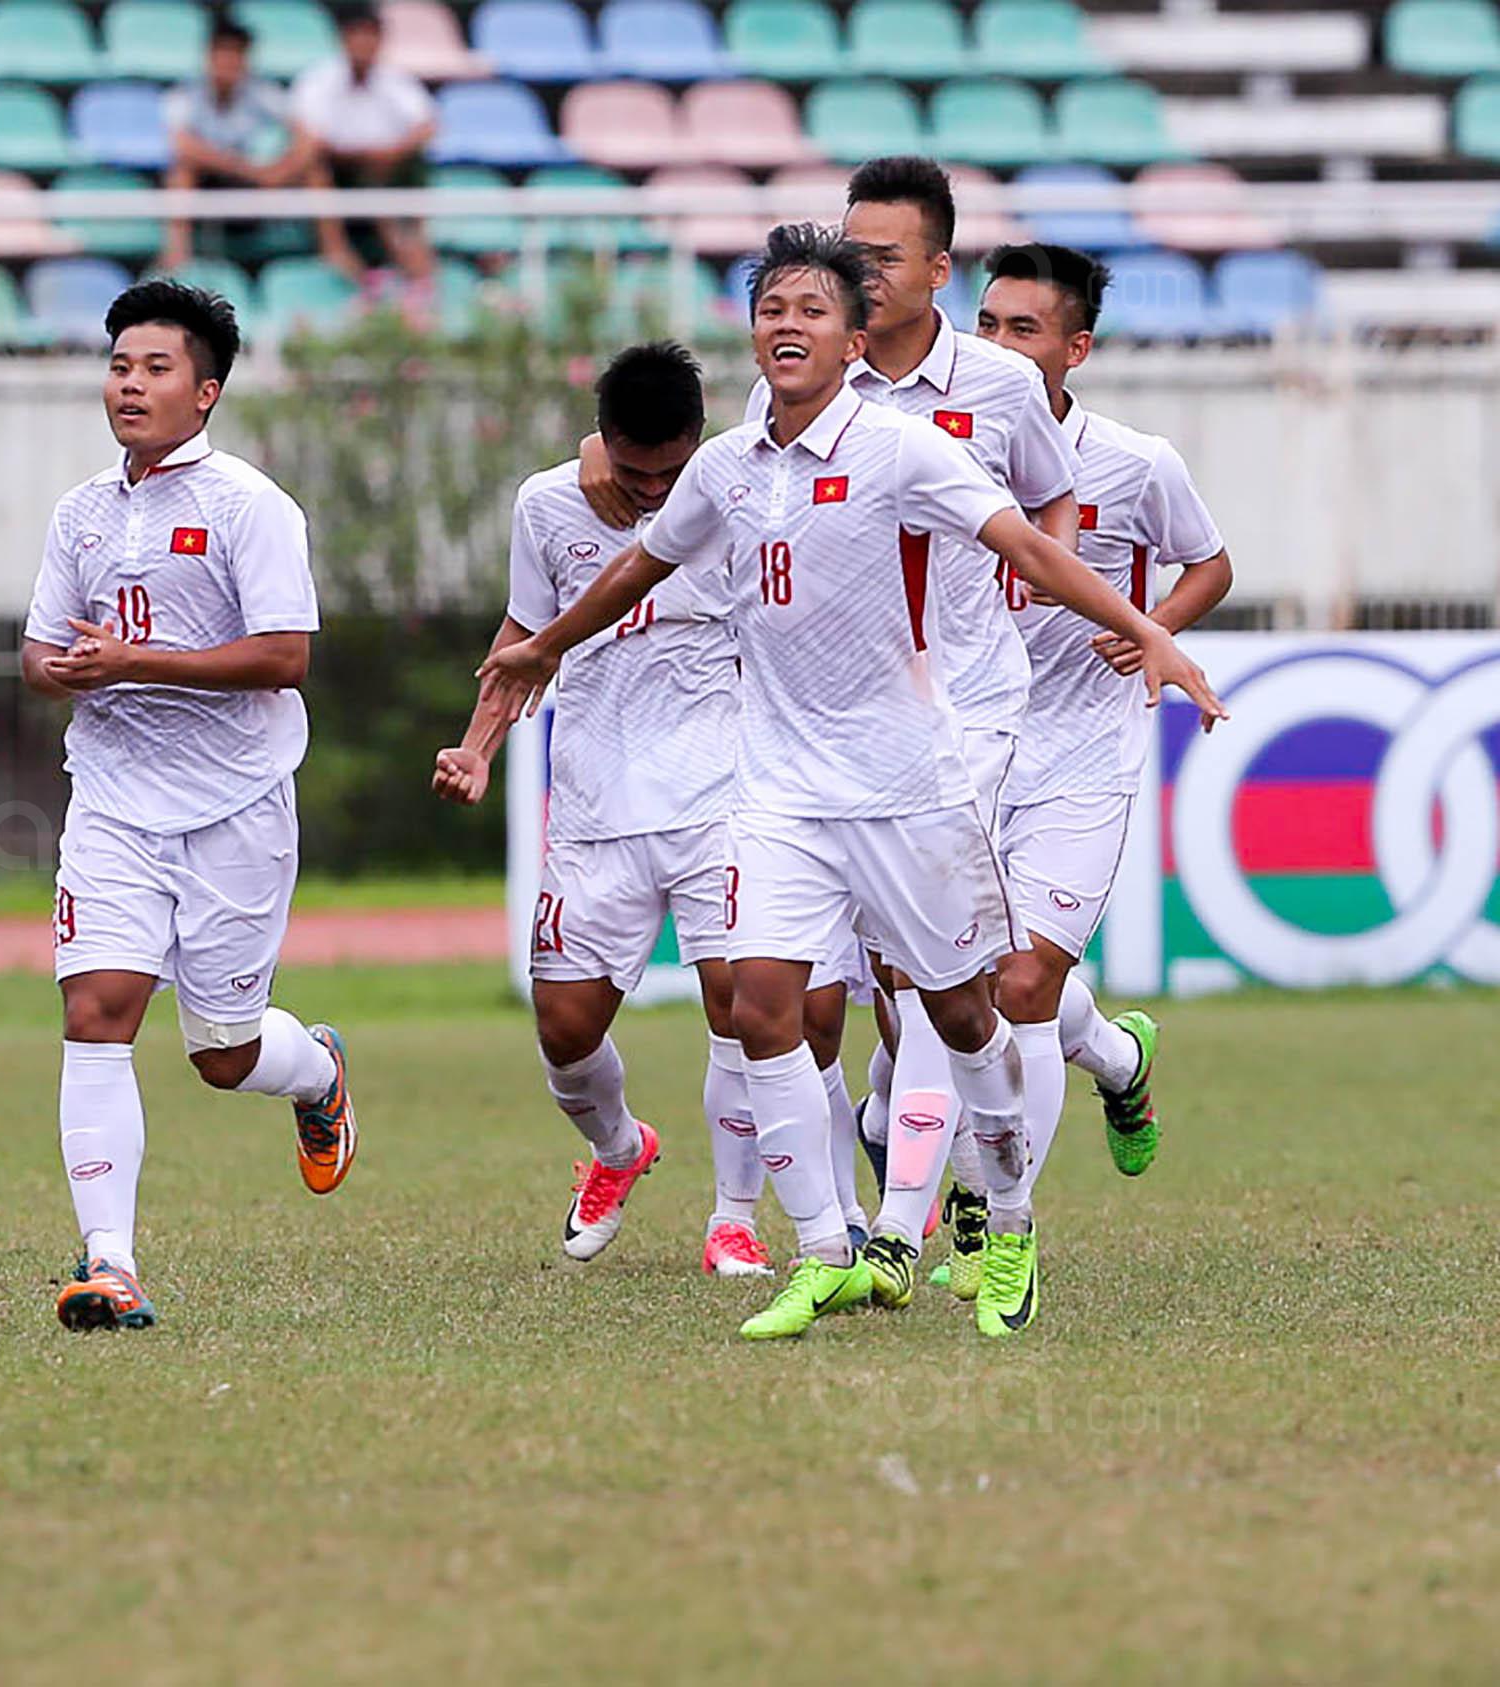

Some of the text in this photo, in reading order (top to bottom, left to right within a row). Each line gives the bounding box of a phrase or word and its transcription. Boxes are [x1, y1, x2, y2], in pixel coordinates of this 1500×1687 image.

[760, 540, 792, 606] 18
[117, 585, 151, 645] 19
[535, 891, 564, 954] 21
